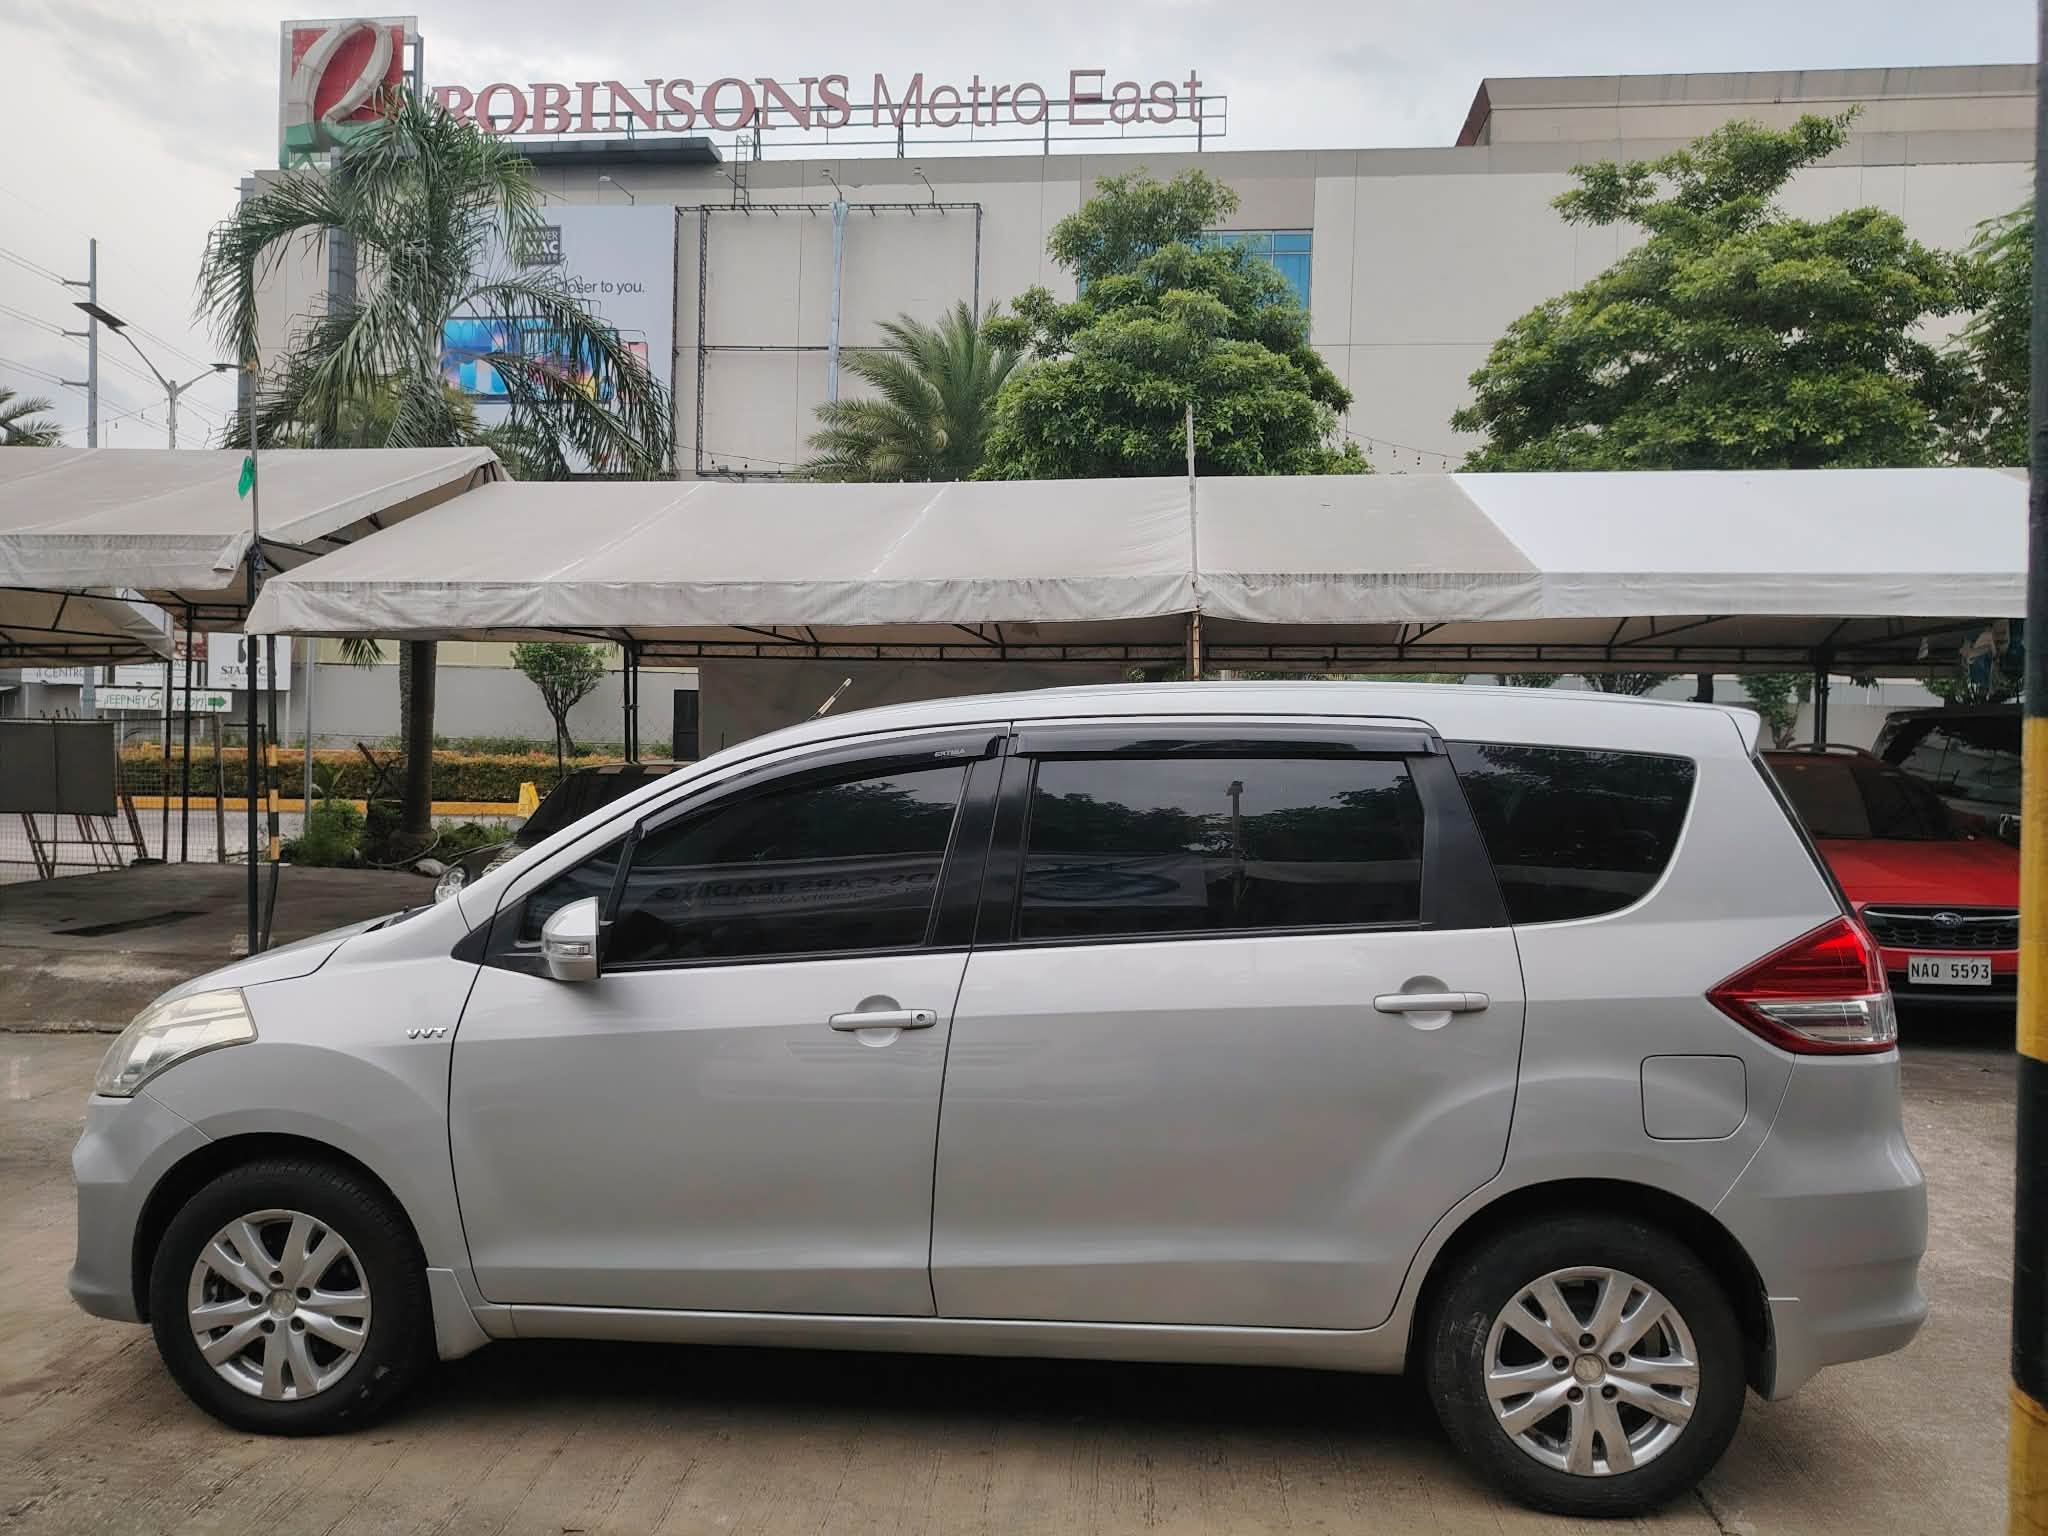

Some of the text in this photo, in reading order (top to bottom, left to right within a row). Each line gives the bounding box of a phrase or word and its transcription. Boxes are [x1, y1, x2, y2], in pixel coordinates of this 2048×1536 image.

[432, 69, 1202, 135] ROBINSONS Metro East
[601, 280, 613, 292] to
[616, 282, 646, 296] you.
[104, 694, 148, 705] JEEPNEY
[1911, 963, 1990, 979] NAQ 5593
